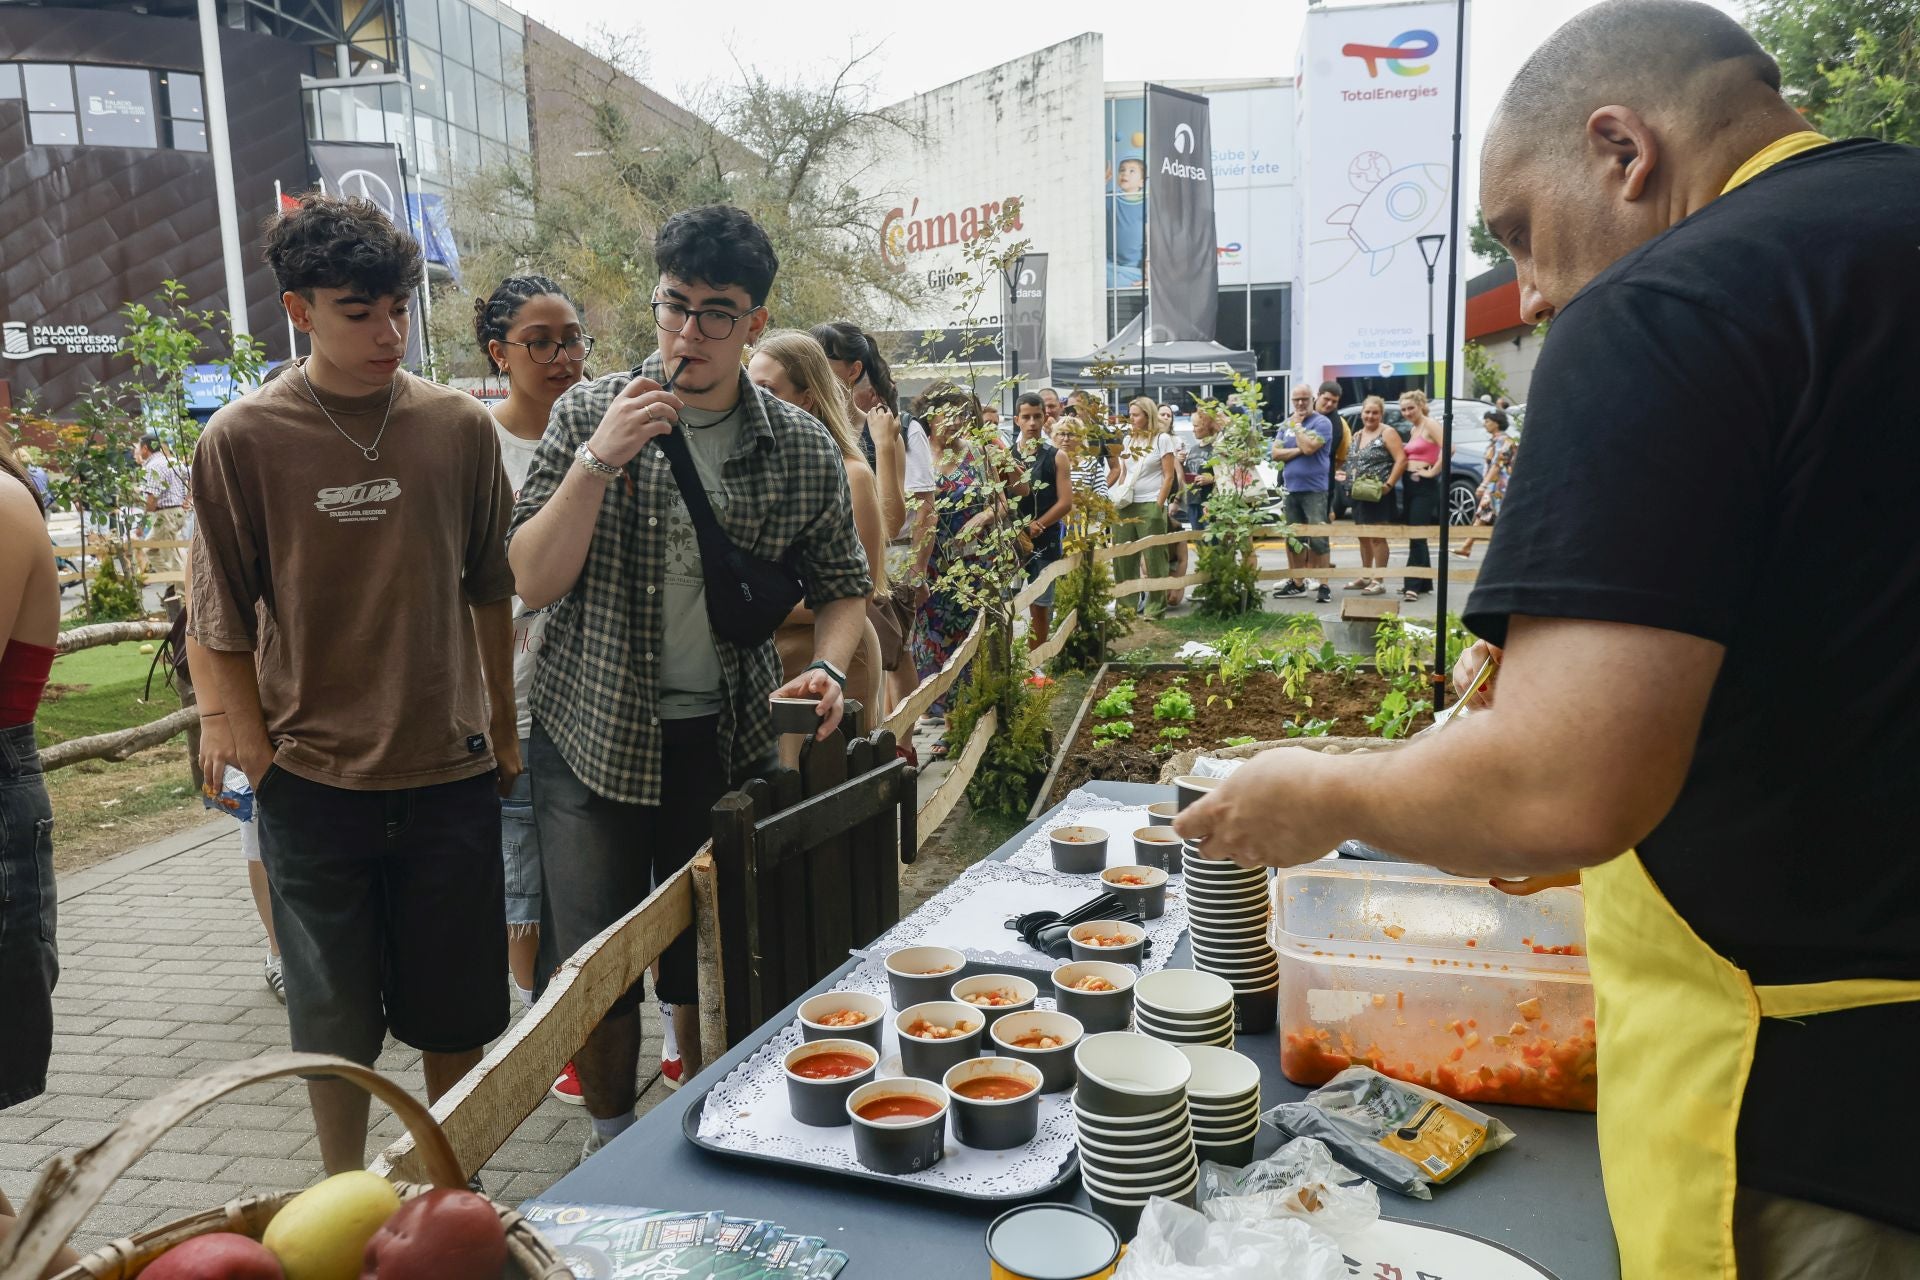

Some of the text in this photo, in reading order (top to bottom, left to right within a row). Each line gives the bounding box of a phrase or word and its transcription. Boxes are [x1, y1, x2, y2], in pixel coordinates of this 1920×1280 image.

[1341, 86, 1438, 102] TotalEnergies
[1251, 150, 1260, 160] y
[1161, 157, 1207, 181] Adarsa
[880, 197, 1024, 272] Cámara
[1009, 287, 1042, 298] darsa
[32, 325, 89, 336] PALACIO
[34, 334, 117, 346] DE CONGRESOS
[67, 344, 83, 354] DE
